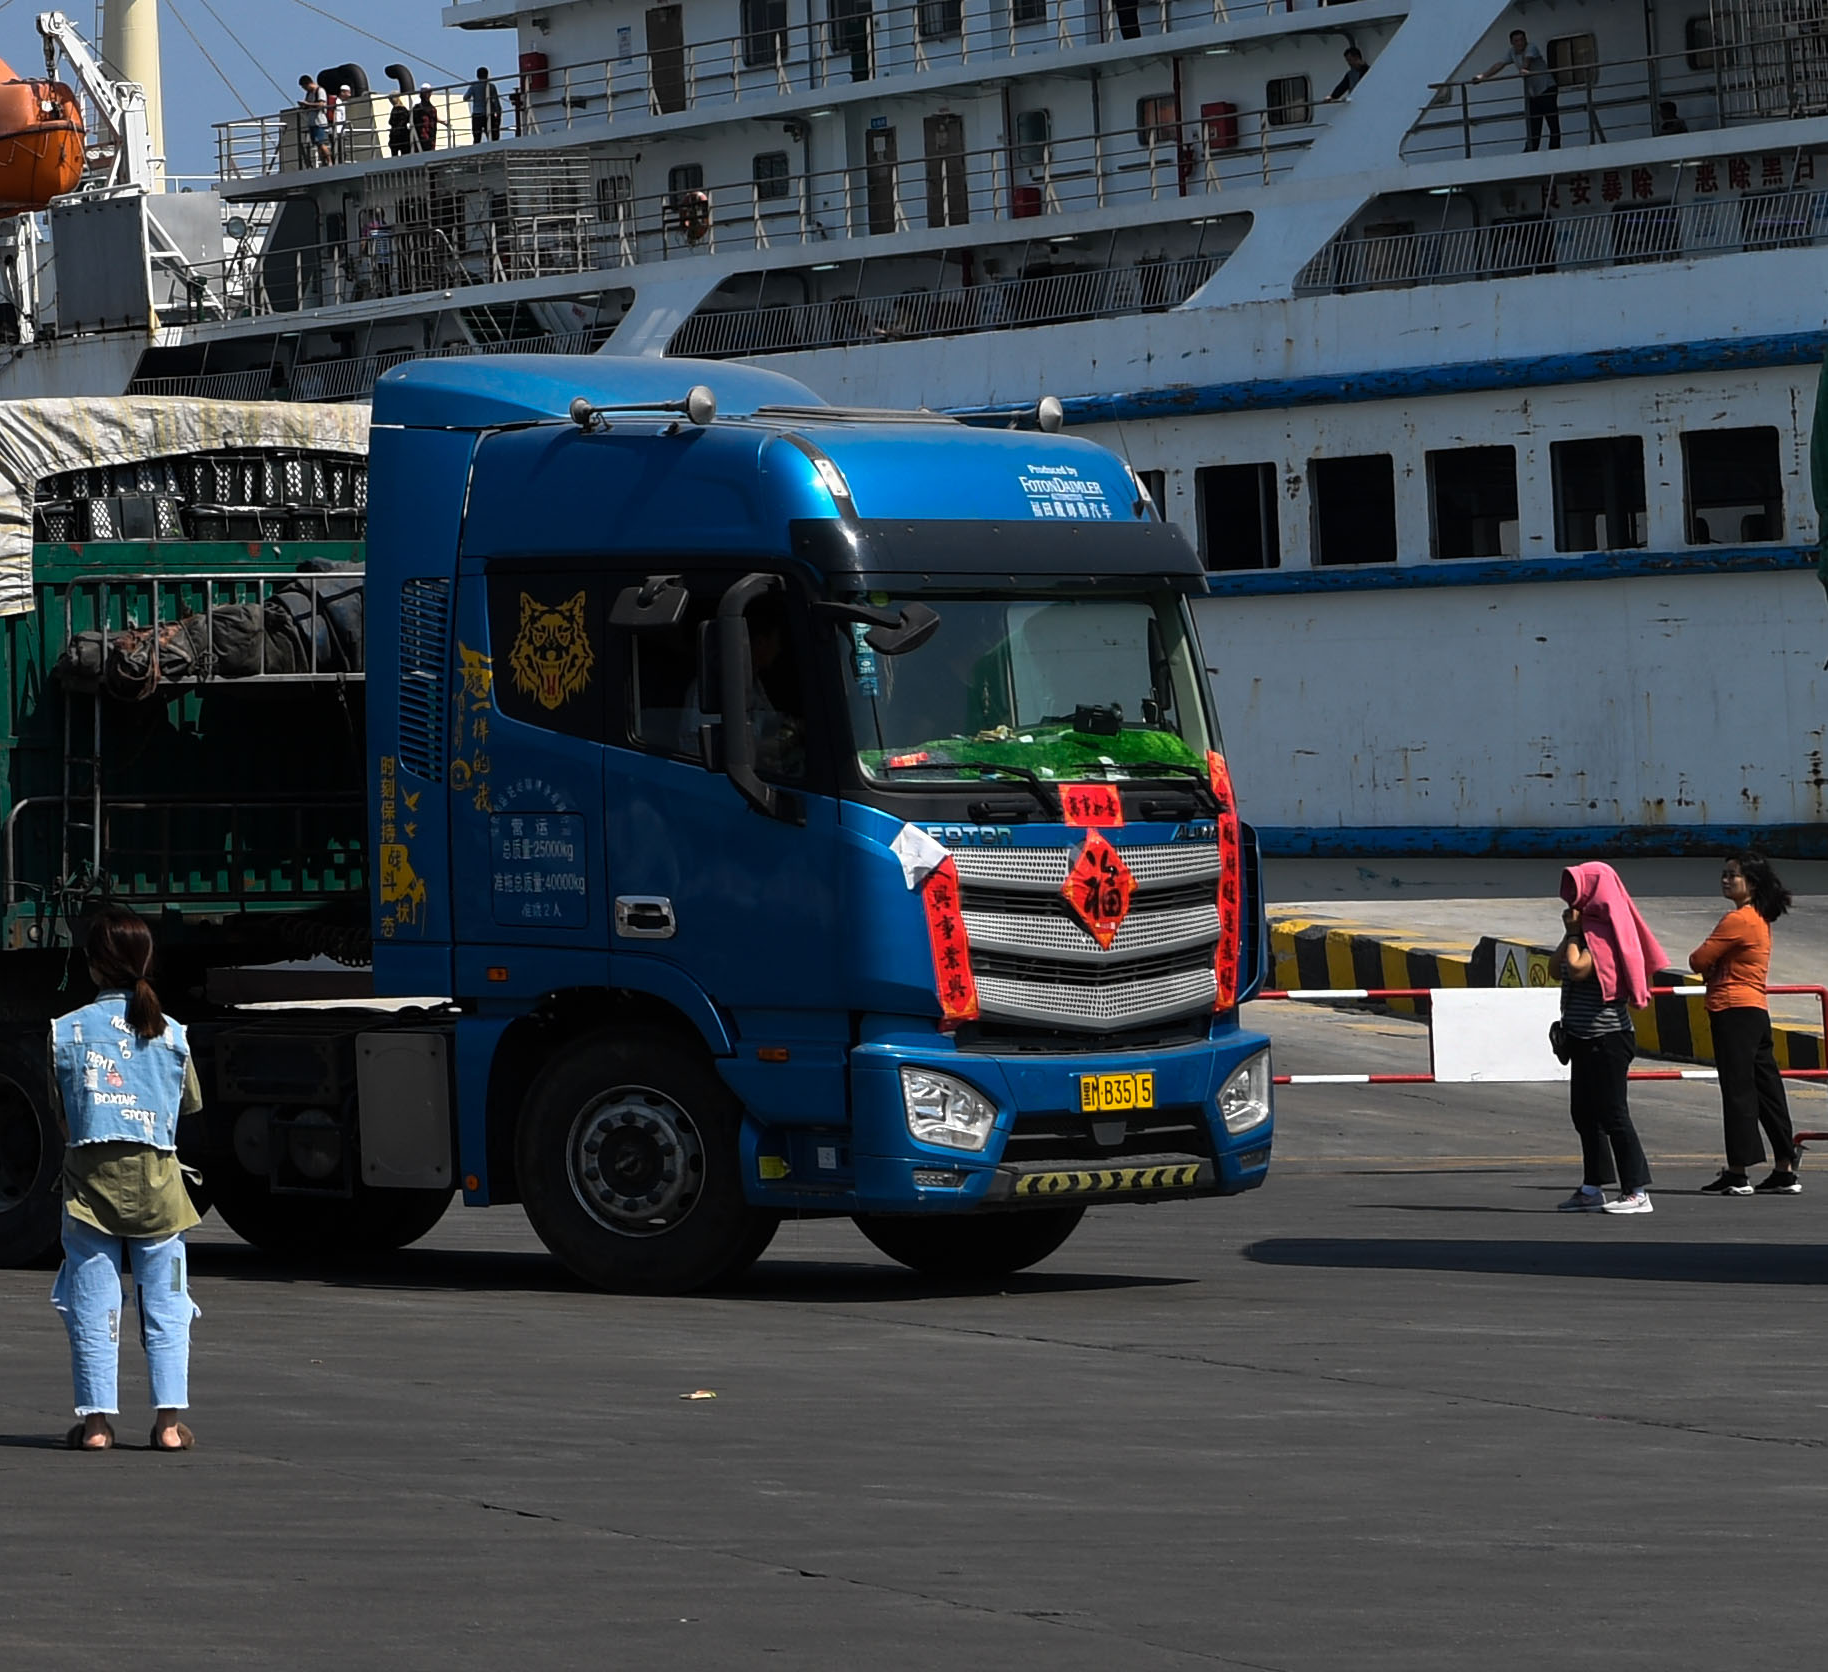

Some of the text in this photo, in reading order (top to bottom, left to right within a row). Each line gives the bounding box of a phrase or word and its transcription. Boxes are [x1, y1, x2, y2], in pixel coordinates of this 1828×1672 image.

[1084, 849, 1123, 921] 福
[94, 1092, 139, 1106] BOXING
[121, 1109, 157, 1125] SPORT
